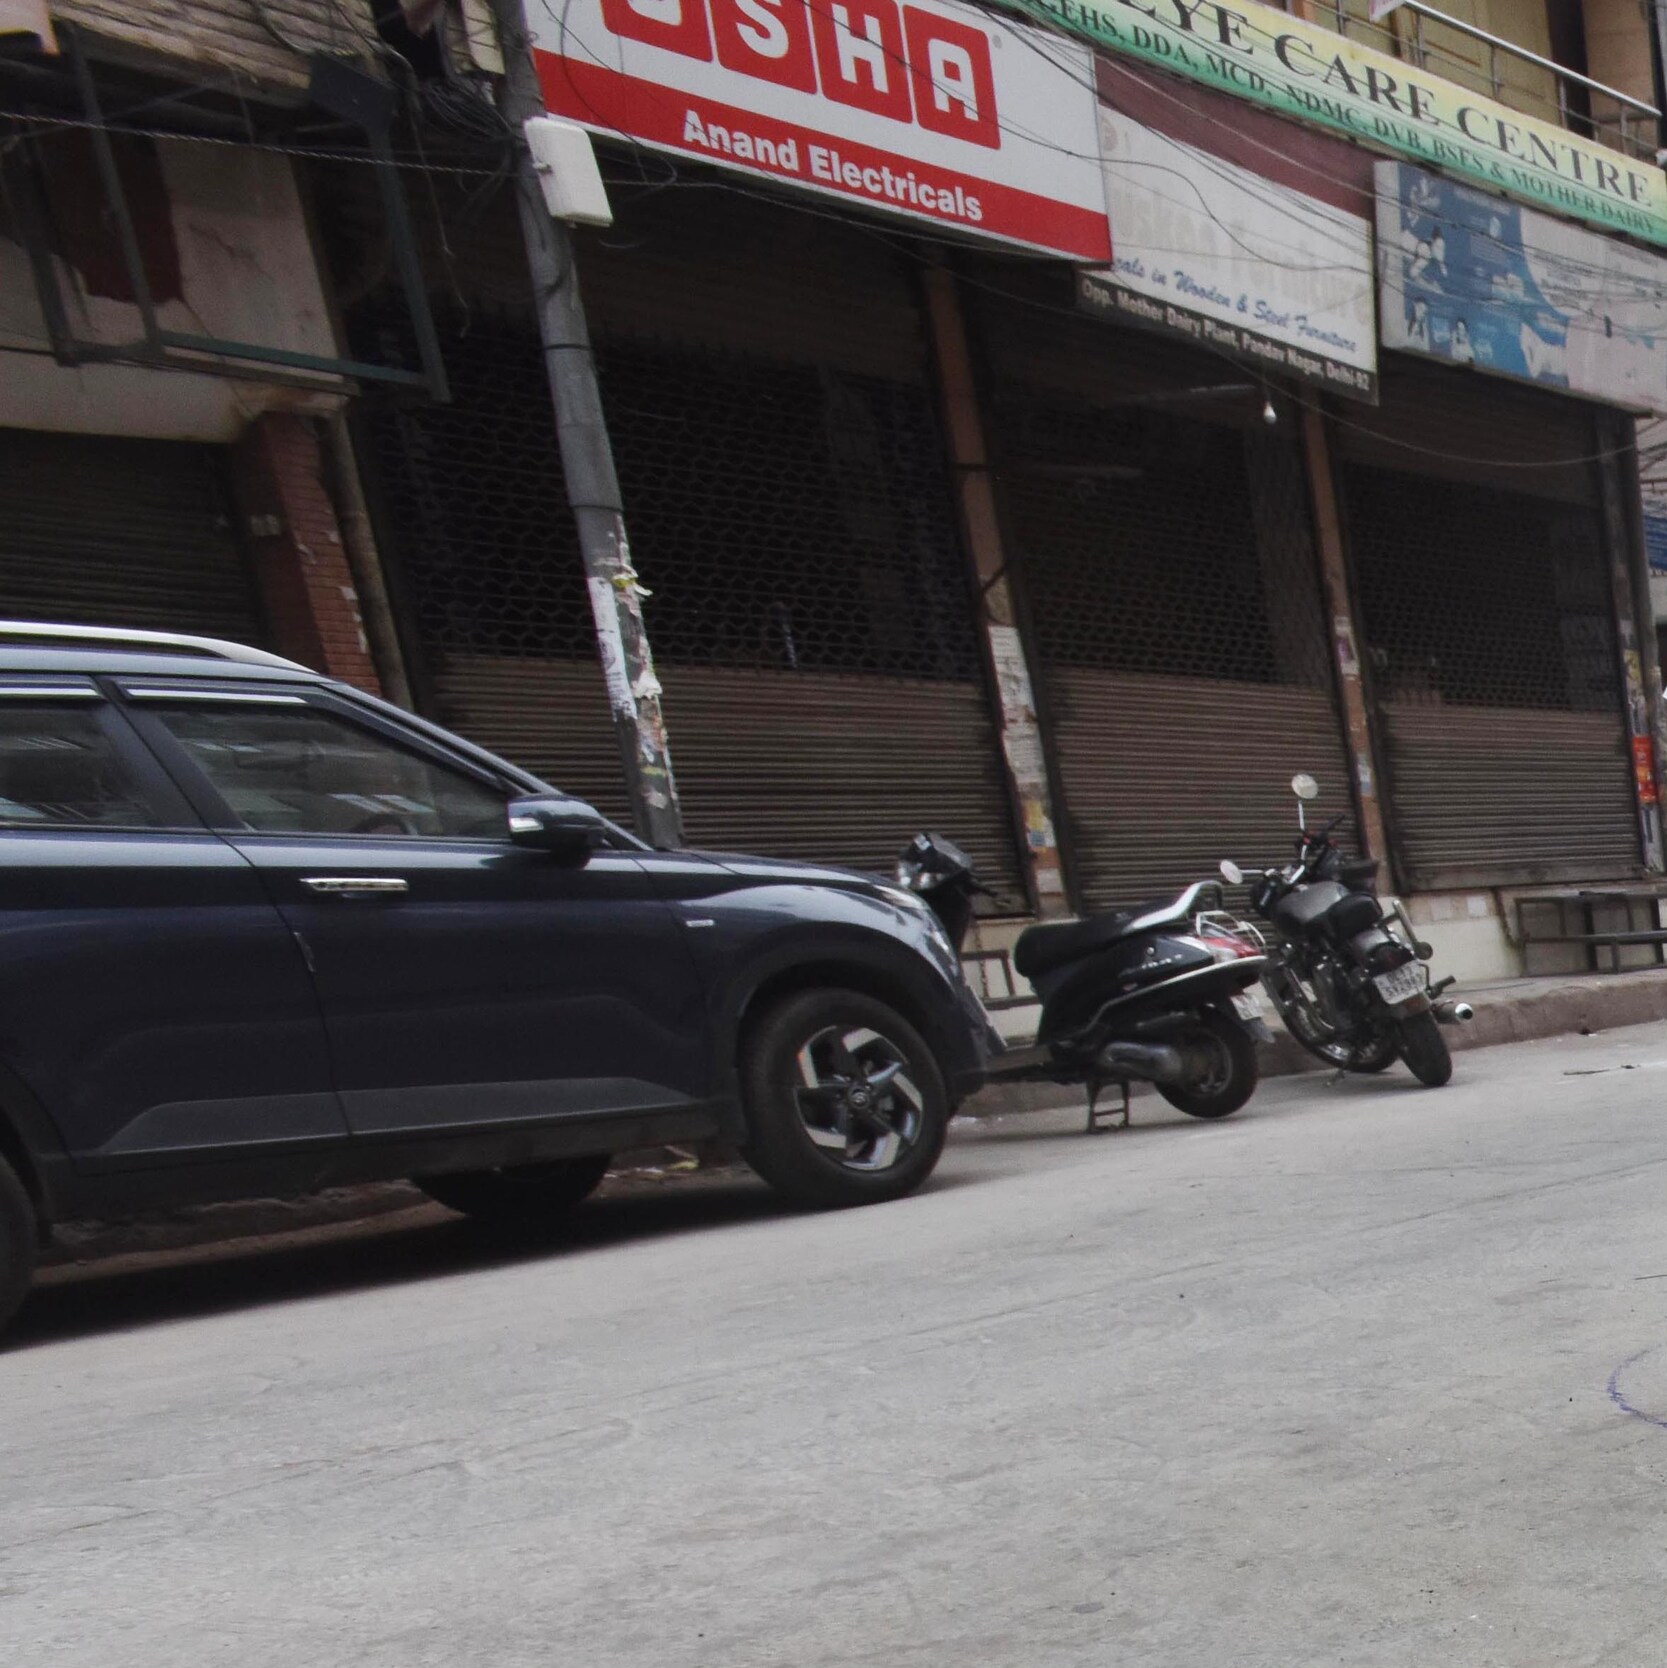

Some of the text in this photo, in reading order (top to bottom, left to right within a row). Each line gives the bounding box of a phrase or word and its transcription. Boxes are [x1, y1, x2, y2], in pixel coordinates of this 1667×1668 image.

[626, 0, 979, 121] SHA
[683, 109, 984, 222] Anand Electricals
[1132, 24, 1198, 71] DDA,
[1204, 54, 1273, 98] MCD,
[1489, 161, 1504, 179] &
[1510, 167, 1597, 213] MOTHER
[1597, 205, 1652, 234] DAIRY
[1274, 34, 1440, 126] CARE
[1456, 106, 1652, 207] CENTRE
[1117, 287, 1163, 321] Mother
[1166, 307, 1201, 339] Dairy
[1152, 268, 1167, 287] in
[1173, 269, 1231, 309] Wooden
[1236, 294, 1248, 314] &
[1253, 299, 1290, 330] Steel
[1295, 314, 1357, 354] Furniture
